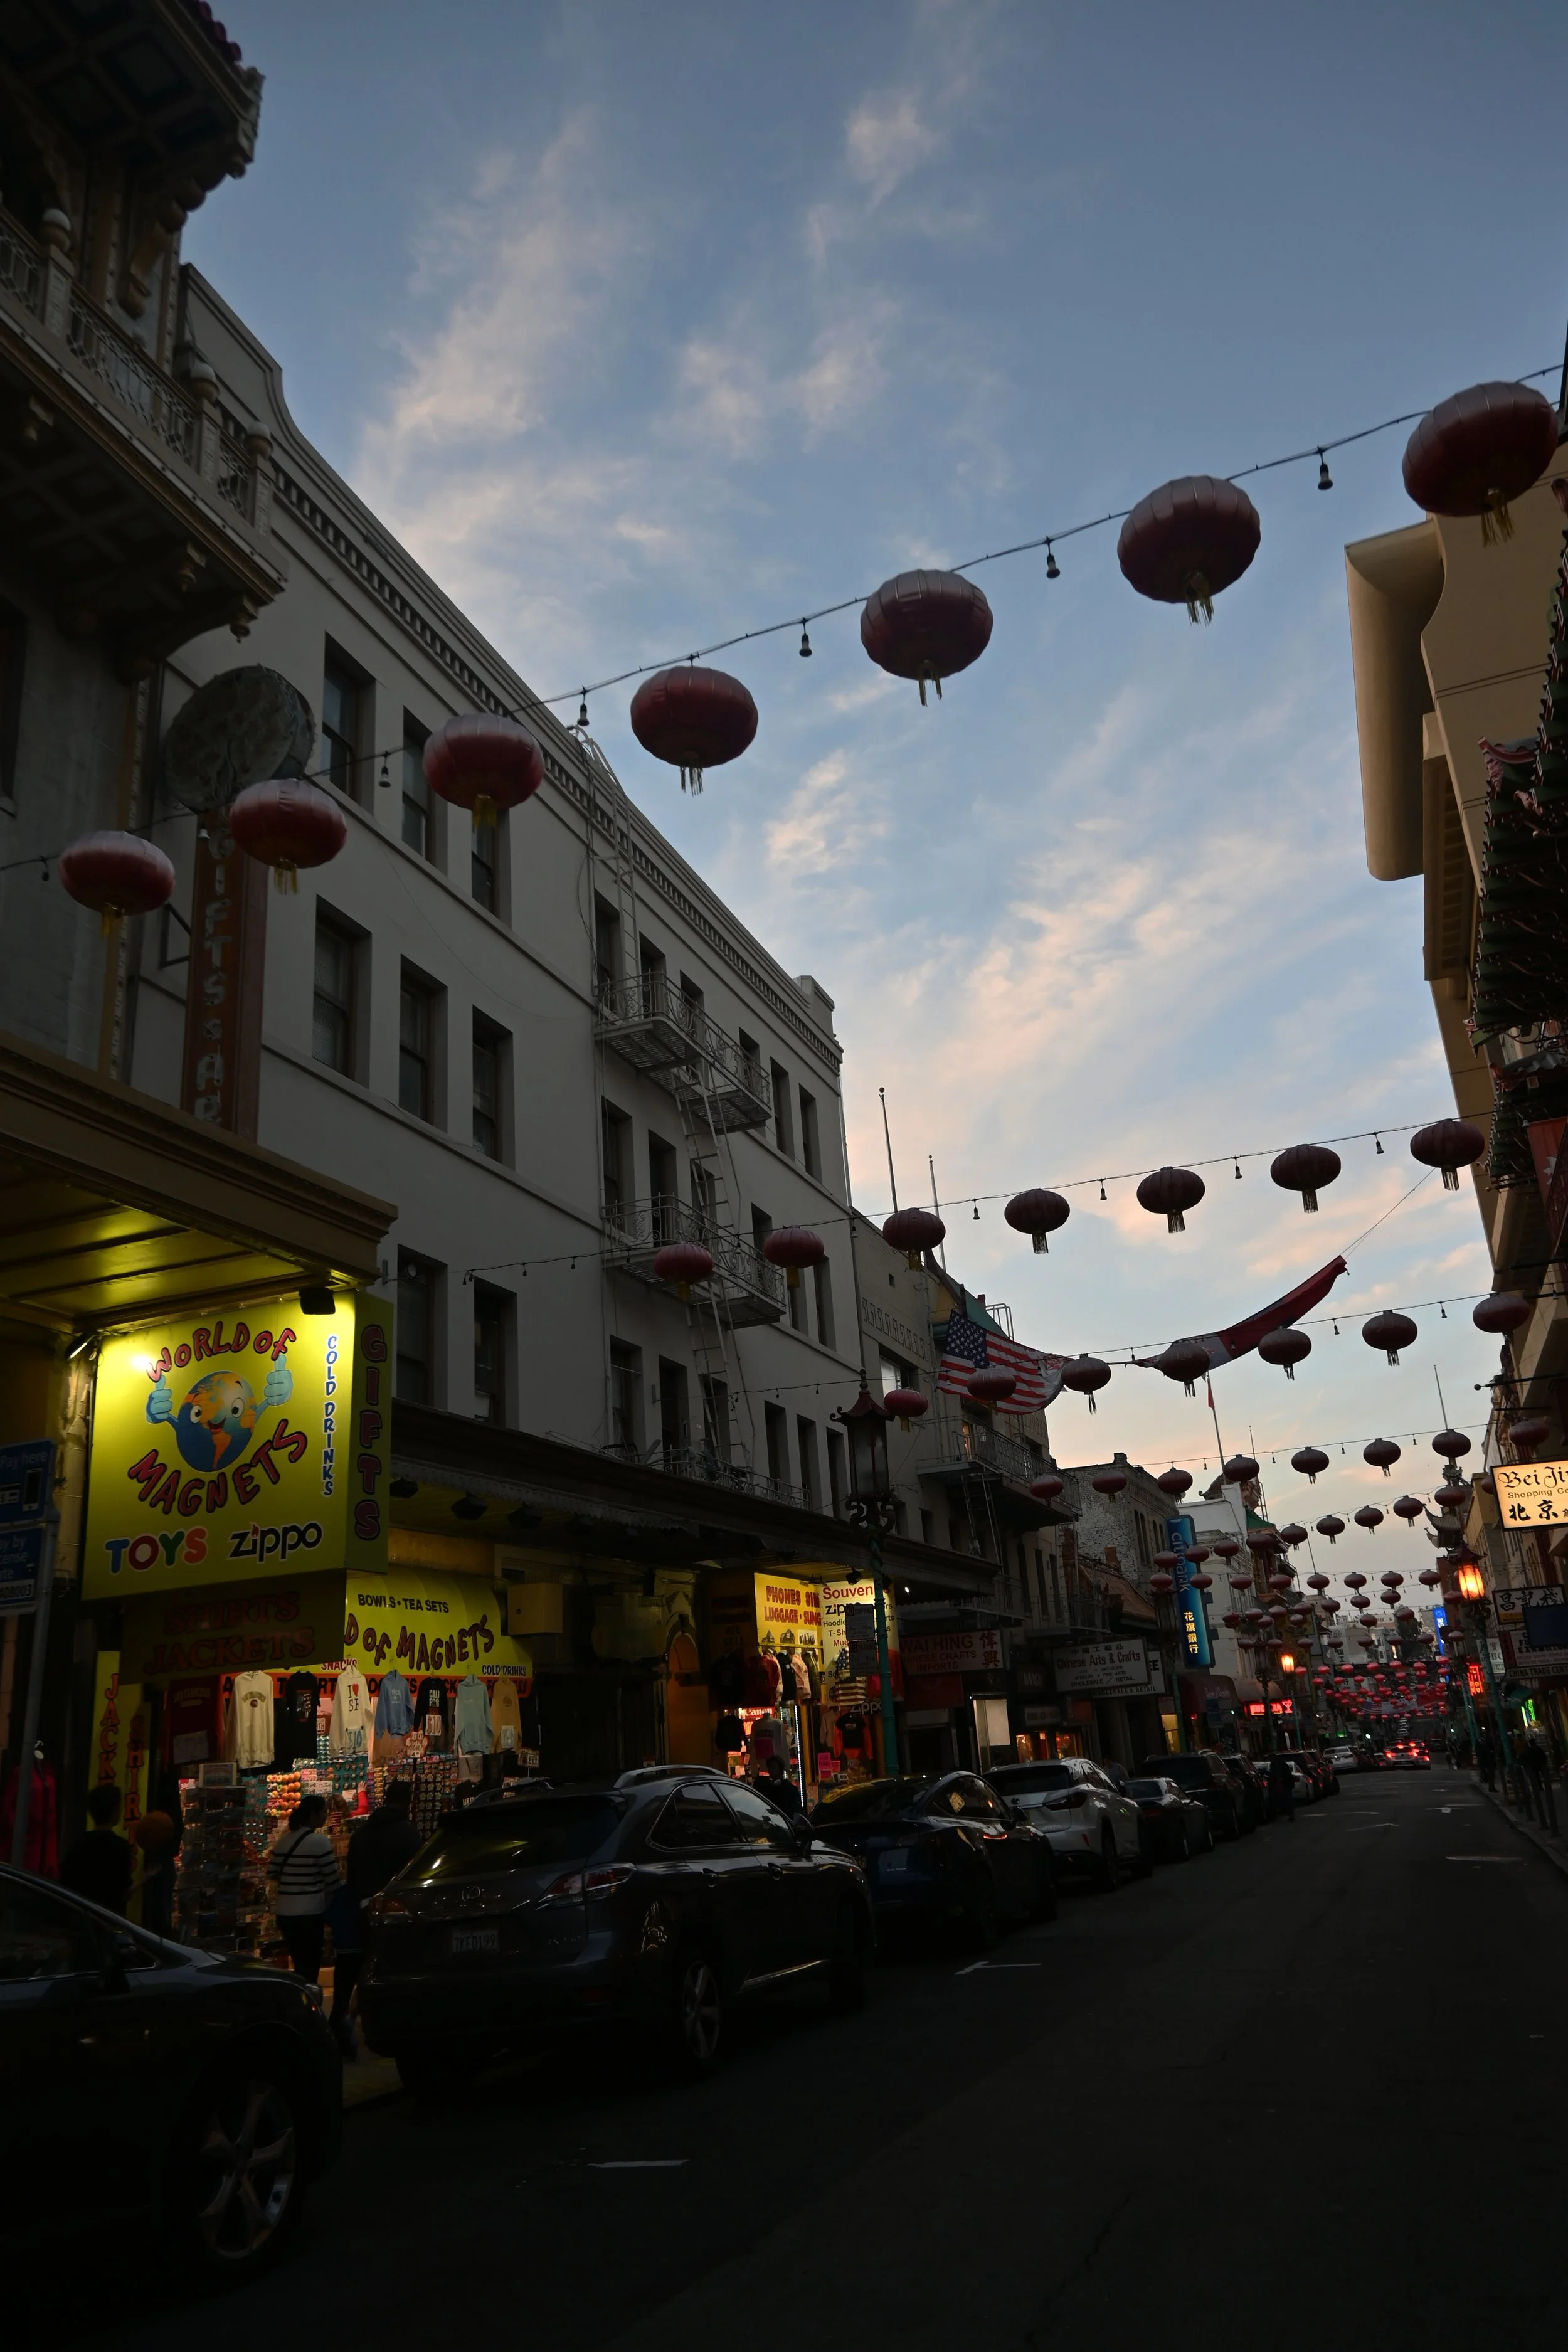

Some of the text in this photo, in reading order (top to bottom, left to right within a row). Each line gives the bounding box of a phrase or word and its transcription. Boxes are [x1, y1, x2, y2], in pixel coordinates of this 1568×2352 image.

[321, 1335, 337, 1497] COLD DRINKS
[354, 1323, 388, 1540] GIFTS
[21, 1451, 48, 1465] here
[128, 1418, 307, 1517] MAGNETS
[1507, 1489, 1553, 1499] Shopping
[105, 1526, 207, 1574] TOYS
[357, 1594, 450, 1614] BOWLS TEA SETS
[766, 1585, 802, 1606] PHONES
[164, 1591, 300, 1635] SHIRTS
[764, 1606, 798, 1624] LUGGAGE
[144, 1626, 315, 1675] JACKETS
[396, 1614, 494, 1672] MAGNETS
[933, 1634, 973, 1650] HING
[903, 1650, 977, 1663] HINESE CRAFTS
[1057, 1650, 1141, 1670] Chinese Arts & Crafts
[482, 1664, 527, 1677] COLD DRINKS
[916, 1661, 959, 1673] IMPORTS
[1508, 1669, 1528, 1678] CHINA
[1529, 1667, 1552, 1675] TRADE
[1069, 1678, 1104, 1687] WHOLESALE
[745, 1708, 773, 1717] Canon
[98, 1673, 120, 1786] JACK
